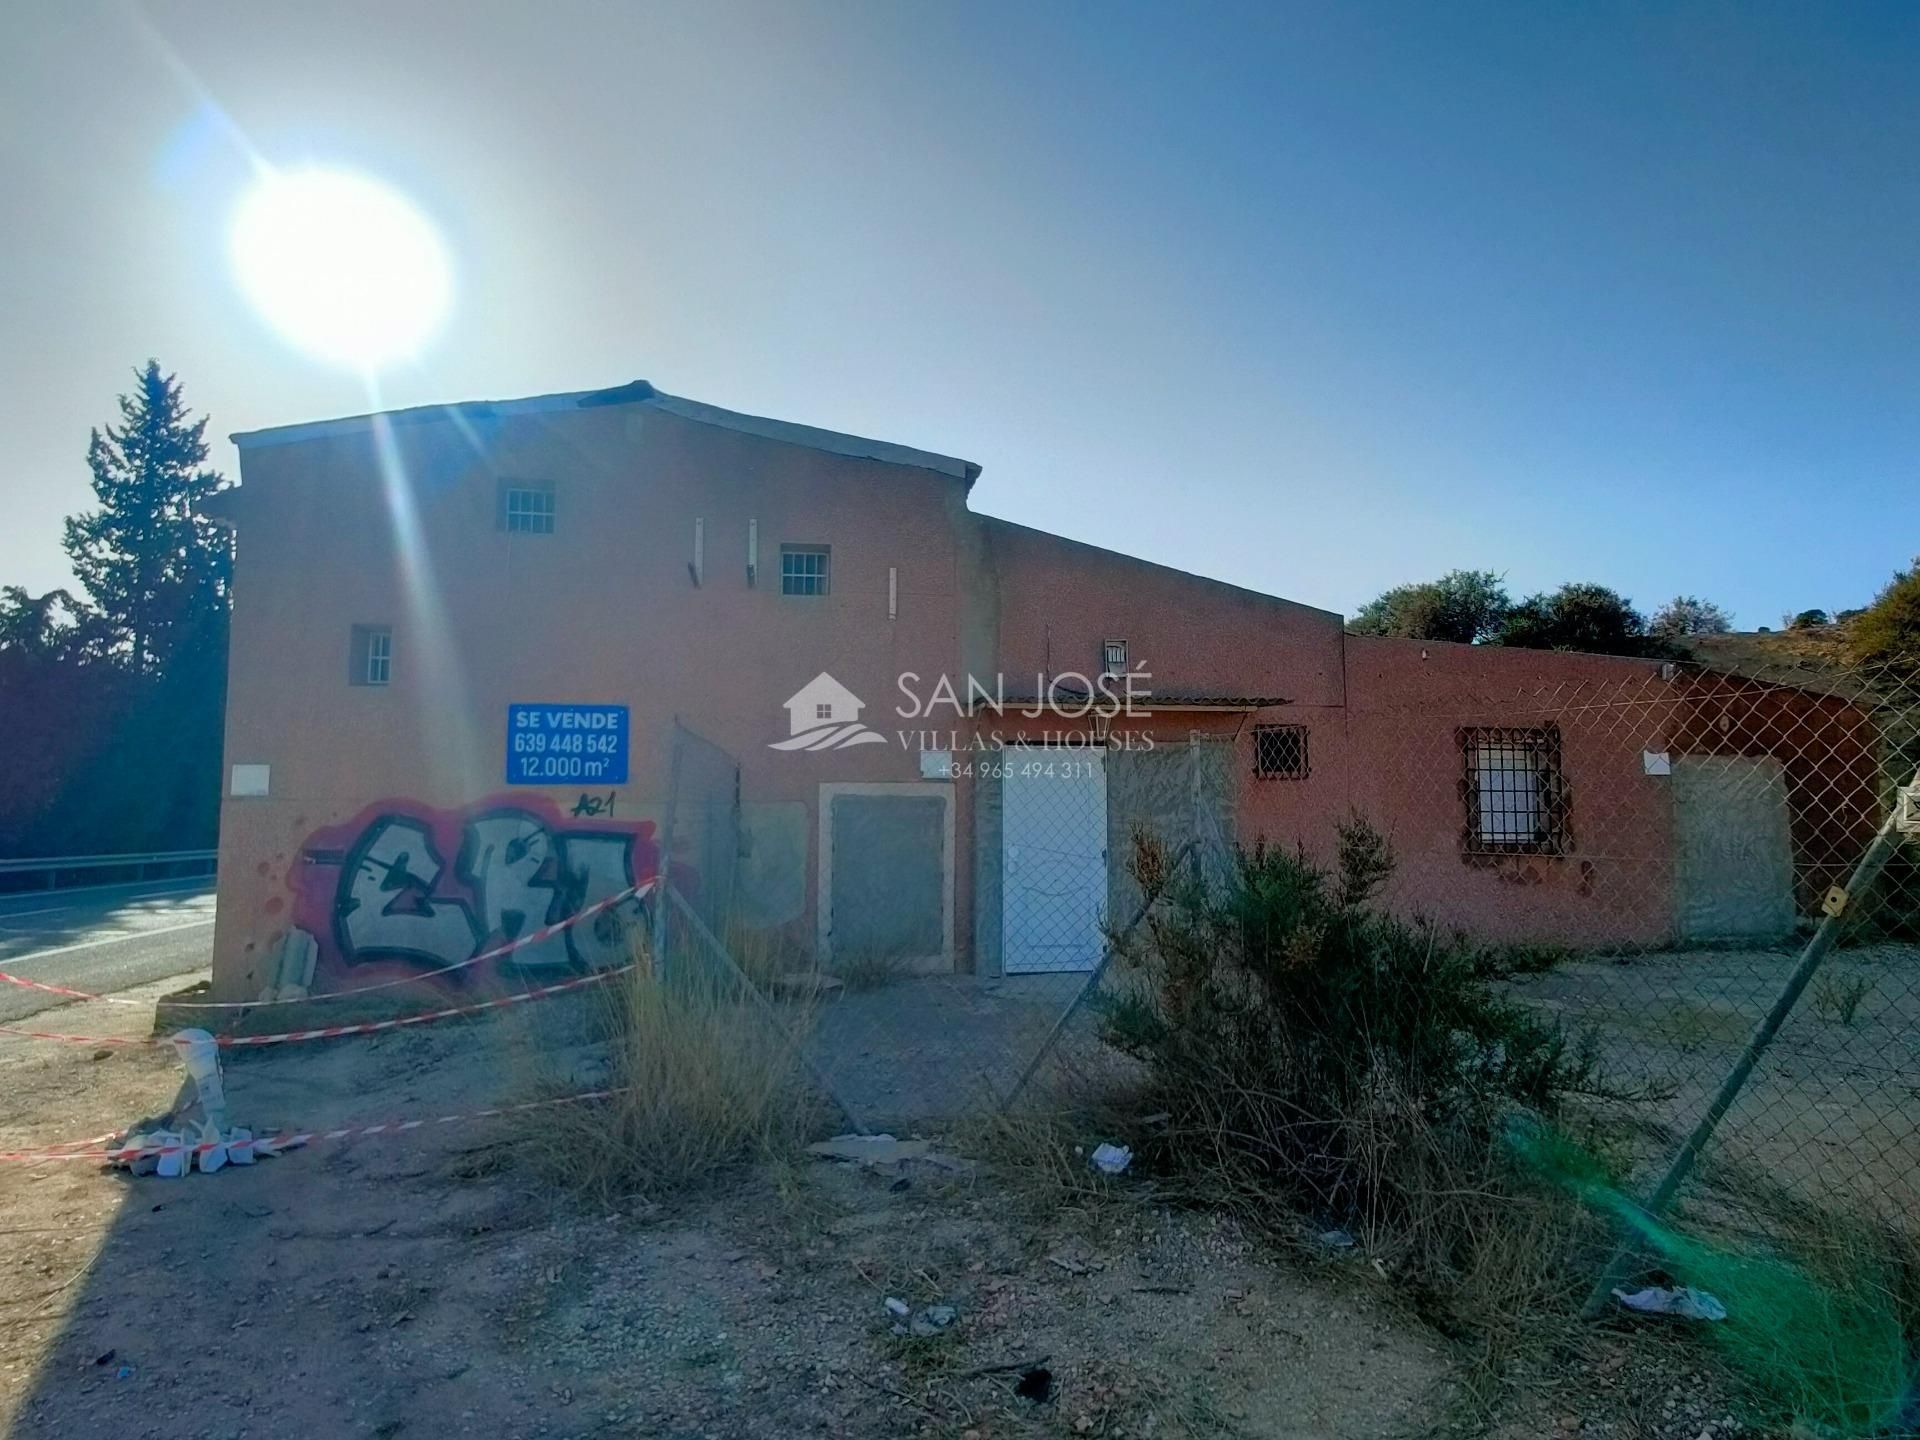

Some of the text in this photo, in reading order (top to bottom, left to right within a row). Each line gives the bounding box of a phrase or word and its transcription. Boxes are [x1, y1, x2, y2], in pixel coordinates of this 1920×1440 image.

[516, 712, 618, 729] SE VENDE
[515, 733, 618, 753] 639 448 542
[520, 757, 581, 776] 12.000
